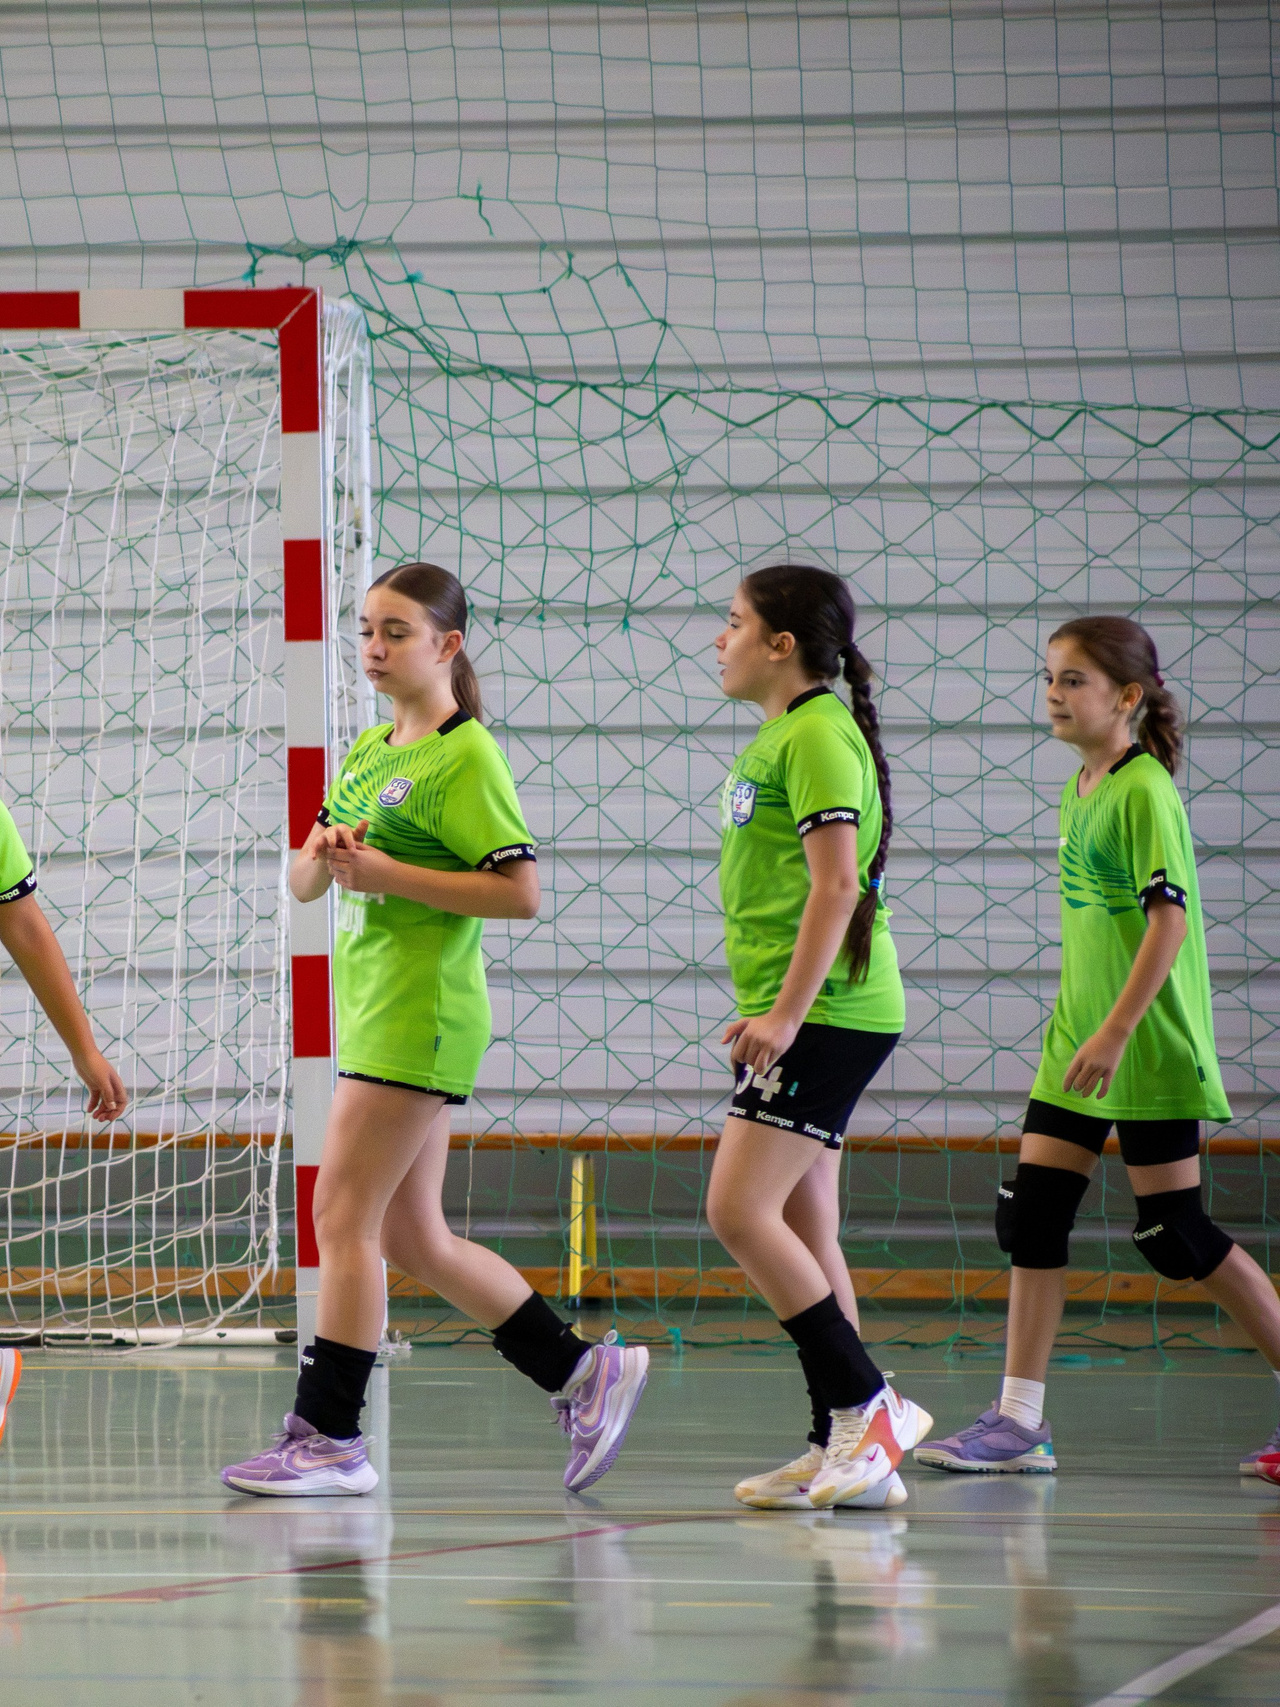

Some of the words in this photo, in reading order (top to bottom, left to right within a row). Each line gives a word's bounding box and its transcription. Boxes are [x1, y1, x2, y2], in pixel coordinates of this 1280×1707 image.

[820, 811, 855, 822] Kempa
[492, 848, 523, 862] Kempa
[756, 1110, 795, 1128] Kempa
[1132, 1223, 1164, 1242] Kempa
